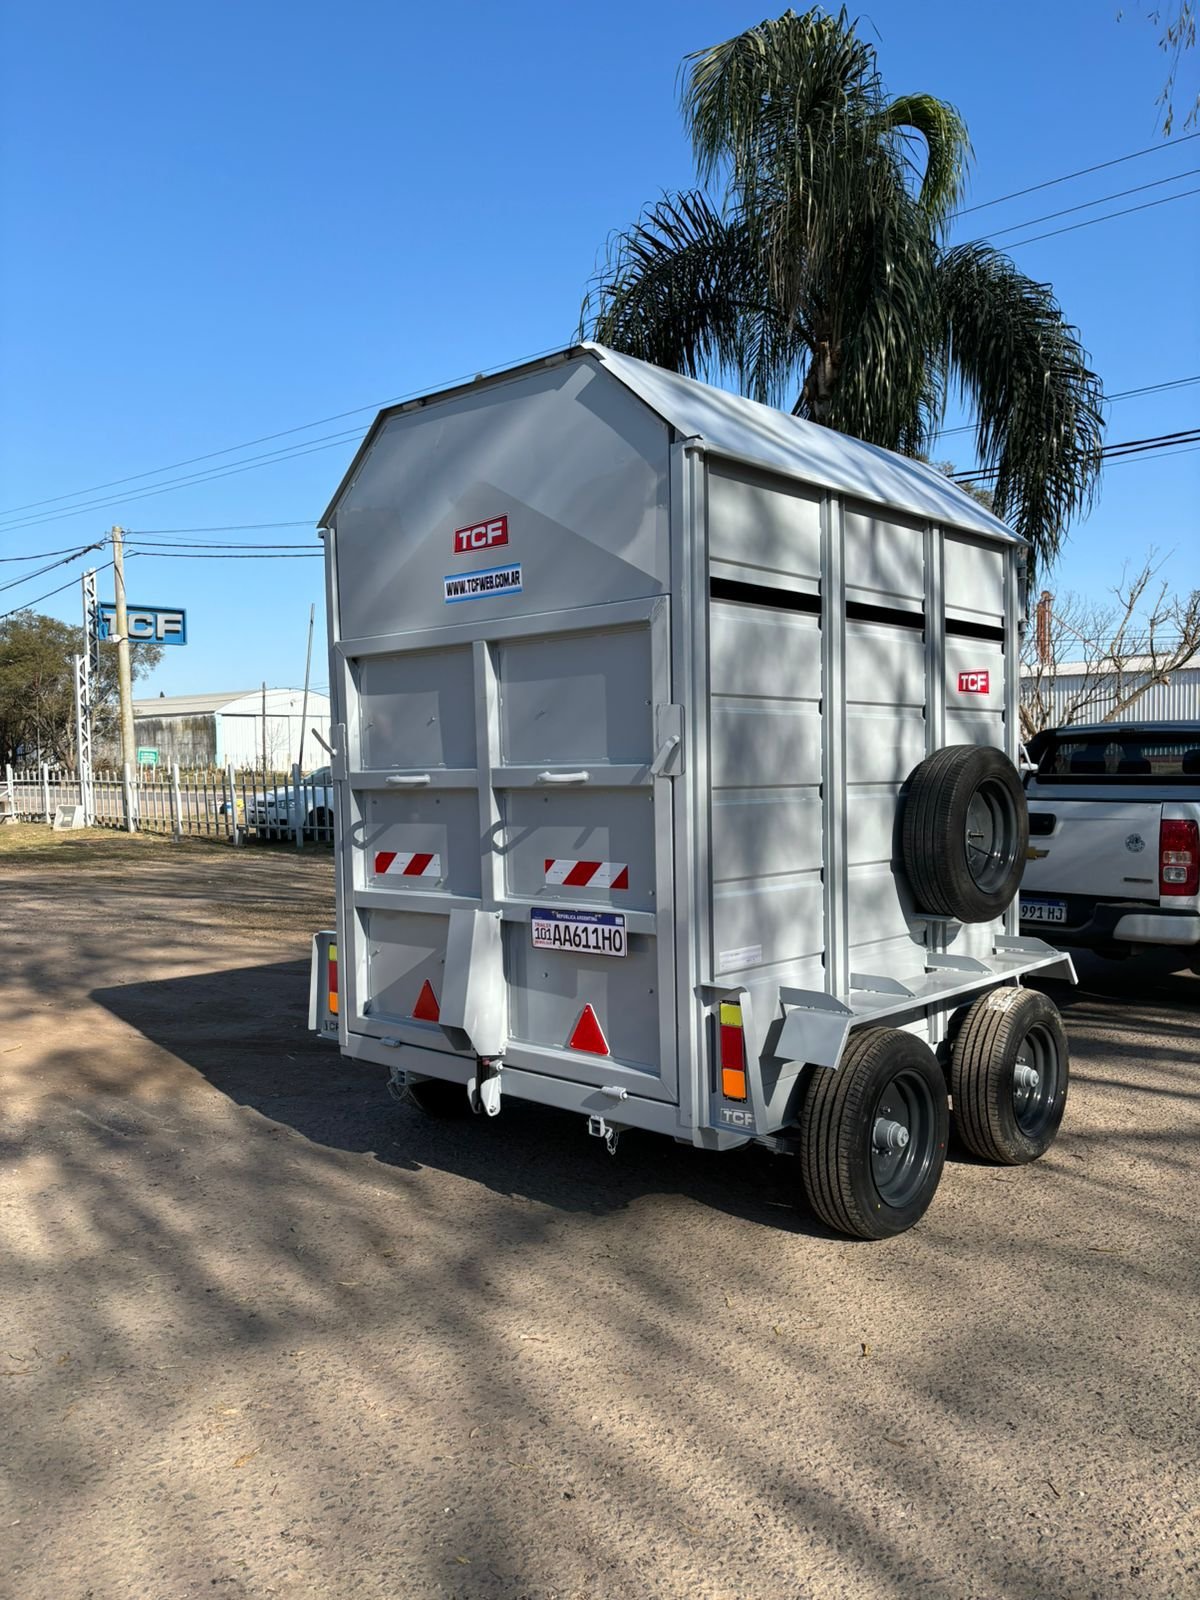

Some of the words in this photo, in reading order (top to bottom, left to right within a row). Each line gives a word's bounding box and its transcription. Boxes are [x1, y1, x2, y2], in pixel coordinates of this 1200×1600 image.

[459, 521, 502, 549] TCF
[446, 570, 520, 597] WWW.TCFWEB.COM.AR
[103, 613, 183, 639] TCF
[961, 674, 986, 691] TCF
[1022, 905, 1043, 919] 991
[1048, 908, 1063, 920] HJ
[534, 927, 552, 940] 101
[723, 1110, 753, 1125] TCF
